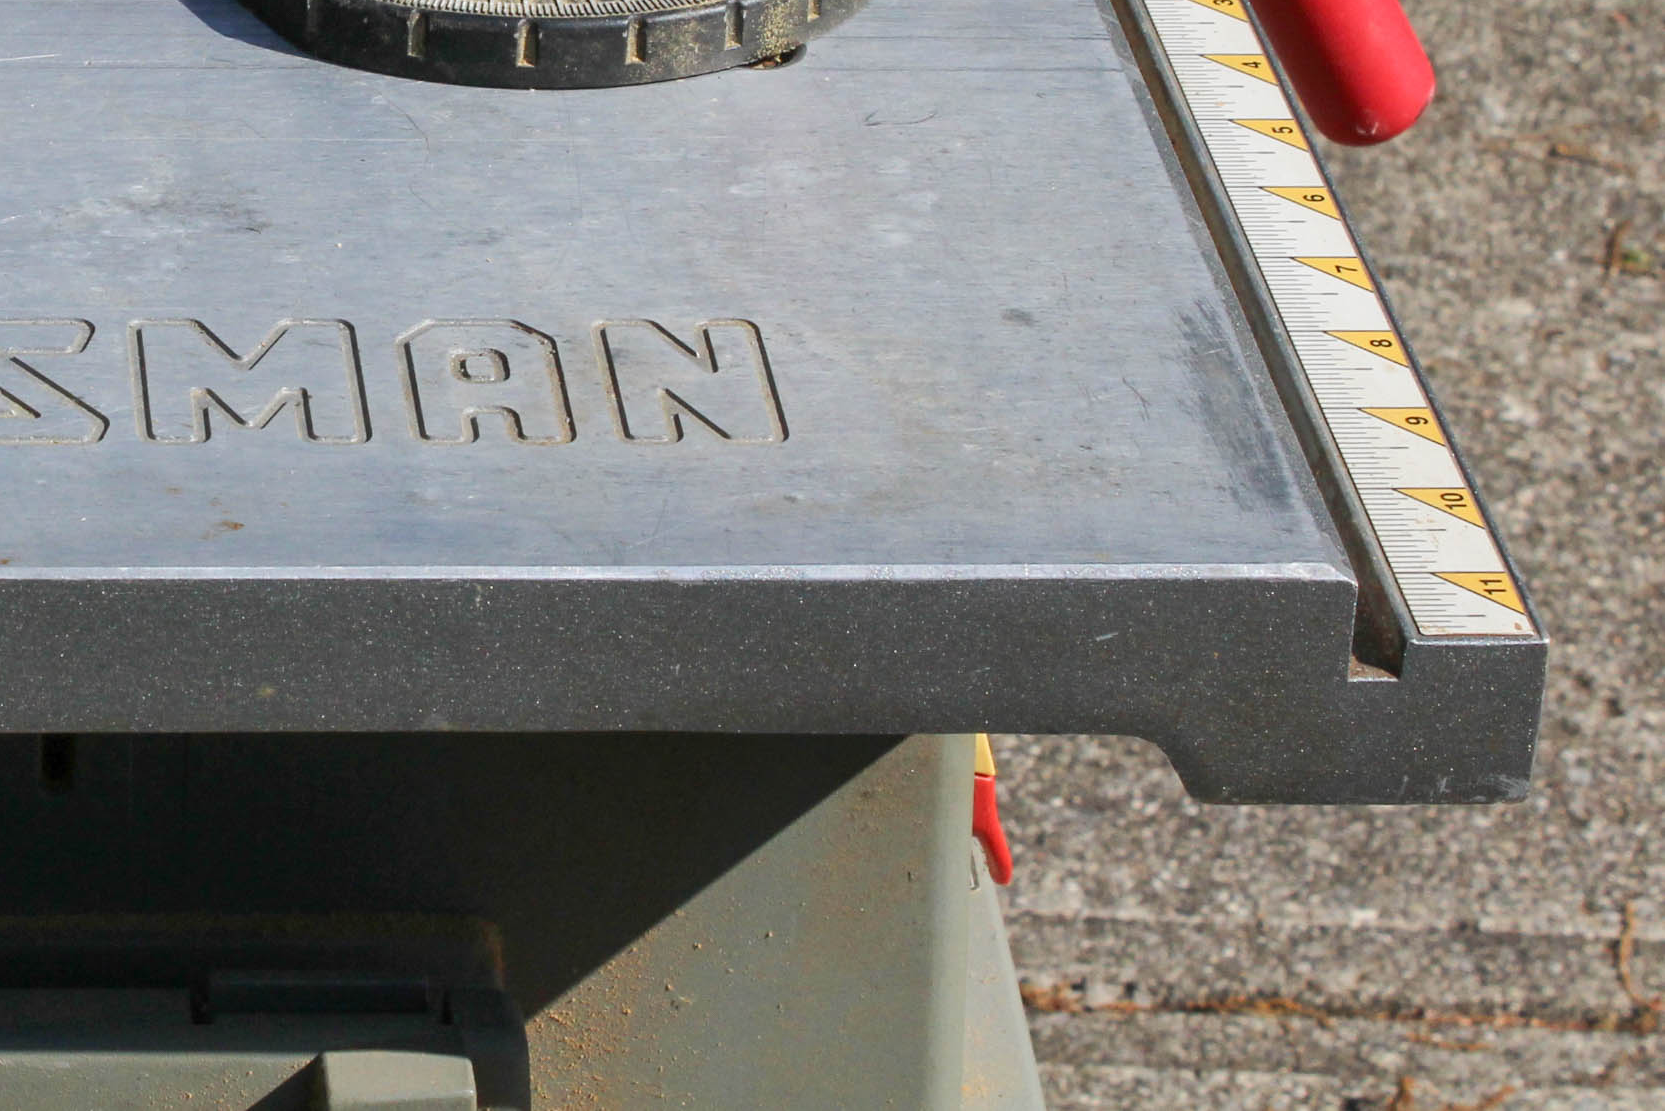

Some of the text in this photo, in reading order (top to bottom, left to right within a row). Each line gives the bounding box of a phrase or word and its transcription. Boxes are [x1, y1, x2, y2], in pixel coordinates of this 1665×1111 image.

[1242, 60, 1262, 69] 4
[1271, 126, 1294, 134] 5
[1302, 193, 1325, 202] 6
[1335, 264, 1358, 274] 7
[1370, 338, 1393, 348] 8
[1405, 416, 1429, 425] 9
[1440, 492, 1467, 509] 10
[1479, 578, 1507, 595] 11
